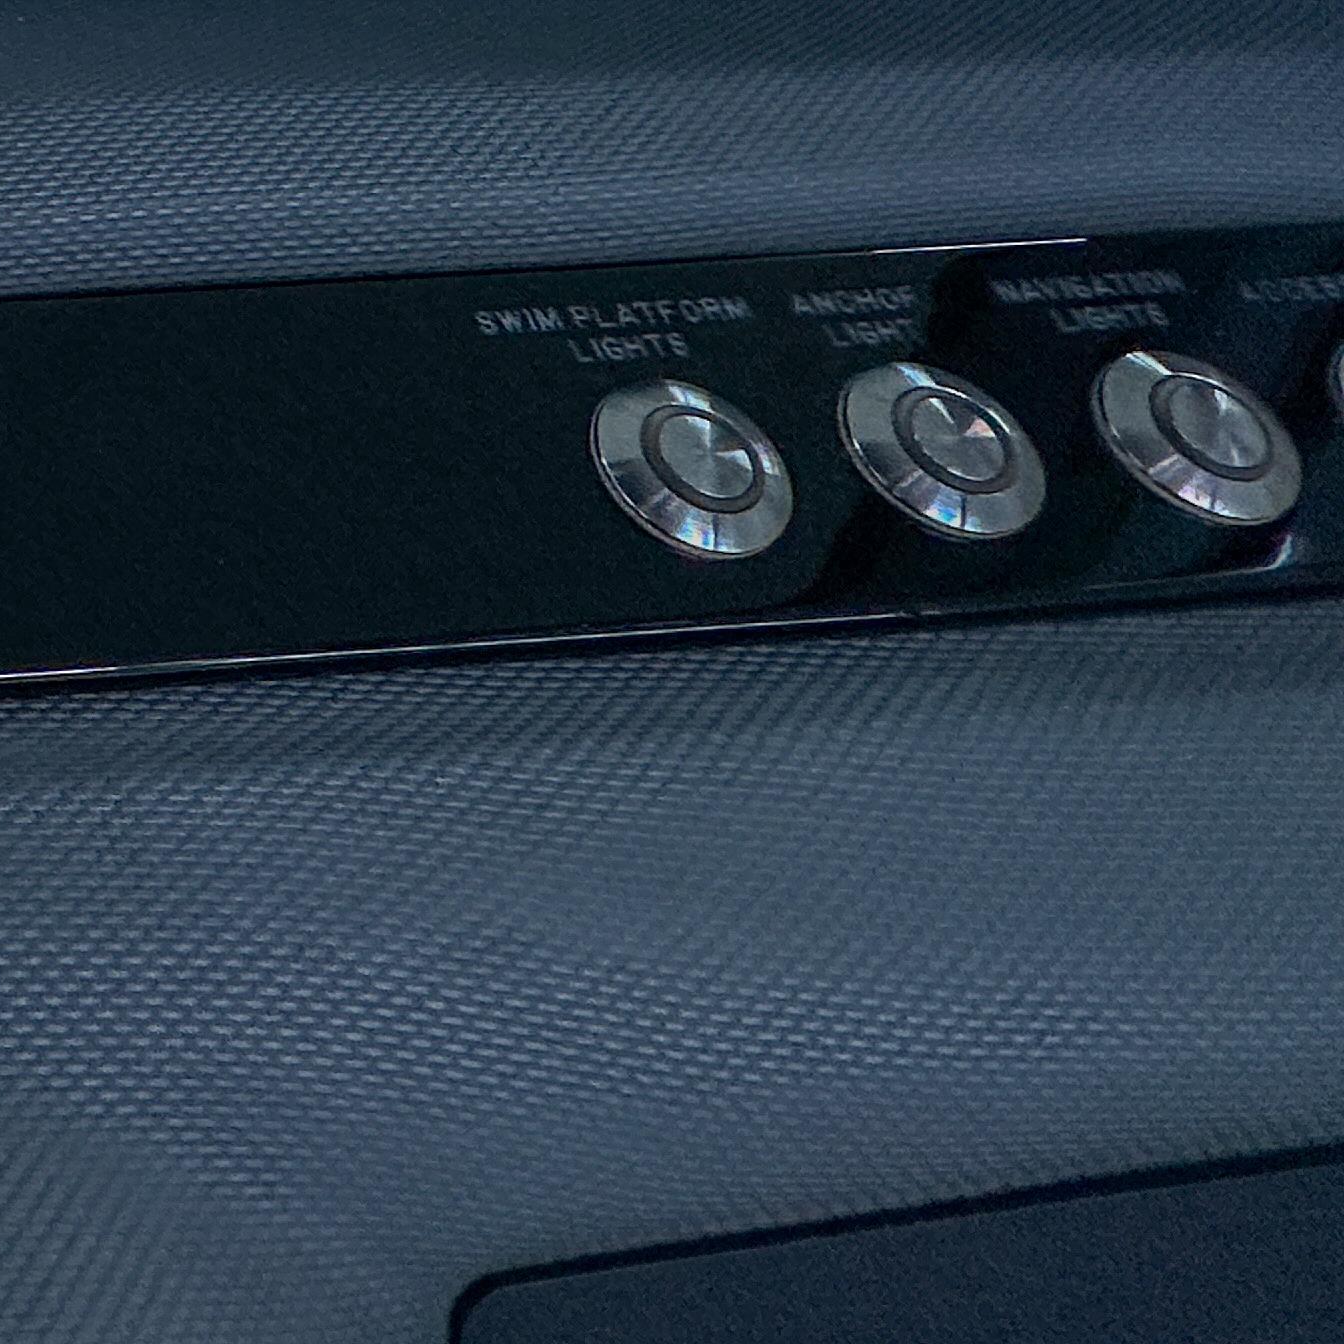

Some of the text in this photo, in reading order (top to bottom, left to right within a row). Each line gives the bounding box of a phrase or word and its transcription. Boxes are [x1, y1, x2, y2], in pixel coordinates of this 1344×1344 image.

[472, 295, 754, 337] SWIM PLATFORM
[1050, 301, 1170, 334] LIGHTS
[567, 332, 690, 364] LIGHTS
